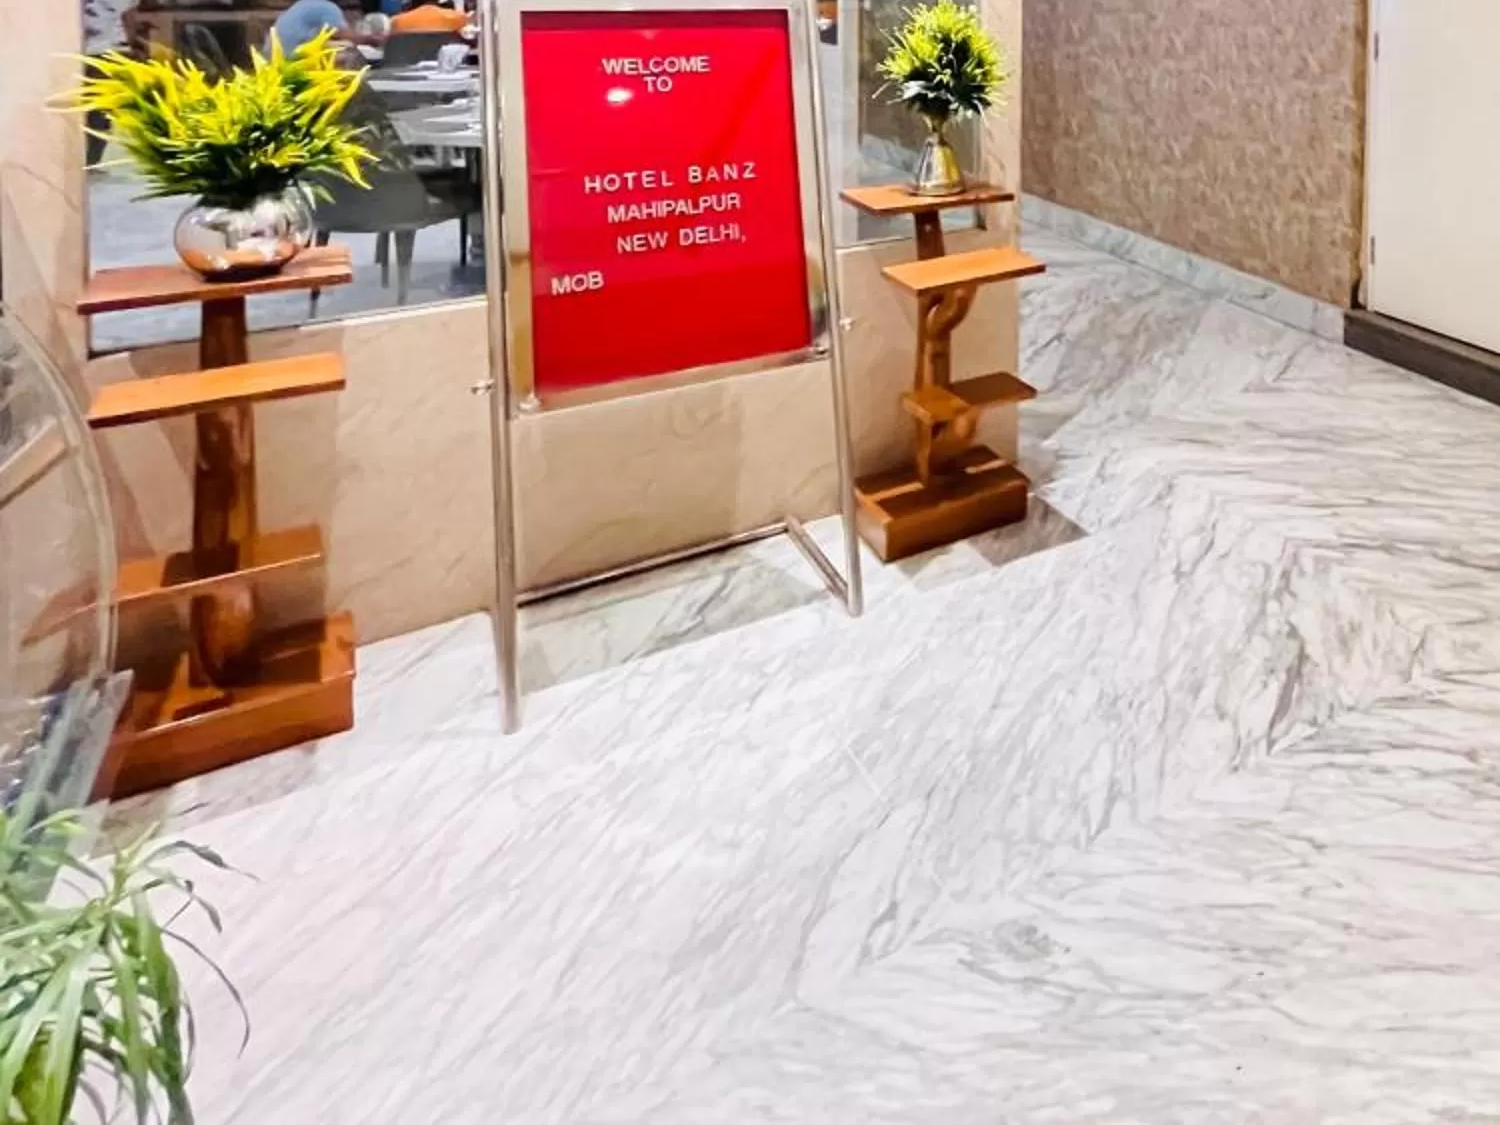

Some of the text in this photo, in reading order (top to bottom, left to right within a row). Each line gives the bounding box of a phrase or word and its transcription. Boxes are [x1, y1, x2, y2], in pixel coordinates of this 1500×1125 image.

[602, 56, 711, 75] WELCOME
[642, 75, 673, 92] TO
[584, 162, 756, 194] HOTEL BANZ
[607, 191, 741, 224] MAHIPALPUR
[617, 223, 747, 253] NEW DELHI,
[550, 271, 604, 296] MOB
